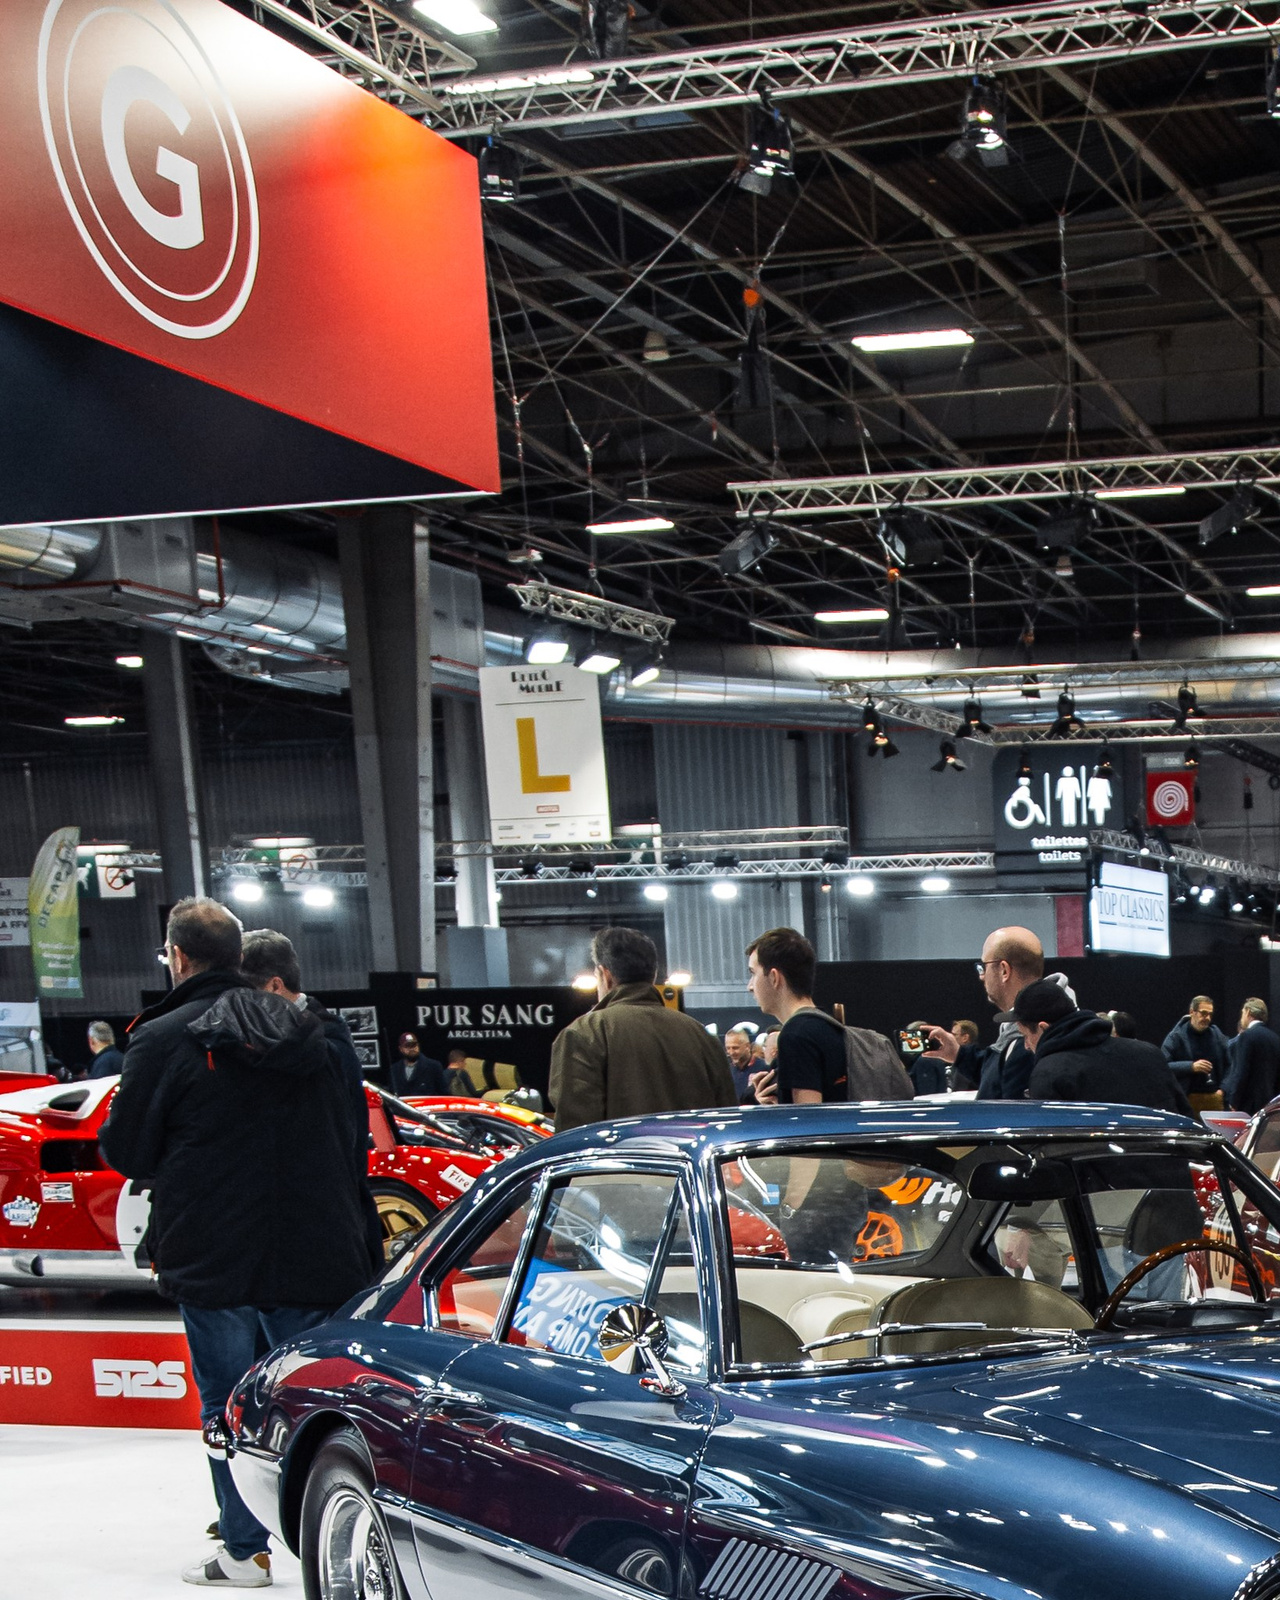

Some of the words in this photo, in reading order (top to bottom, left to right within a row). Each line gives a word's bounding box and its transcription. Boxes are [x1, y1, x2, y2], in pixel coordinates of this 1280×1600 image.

[101, 65, 205, 250] G
[516, 717, 571, 794] L
[1031, 835, 1089, 848] toilettes
[1039, 850, 1082, 862] toilets
[1098, 890, 1118, 917] TOP
[1119, 893, 1165, 923] CLASSICS
[417, 1004, 473, 1027] PUR
[481, 1003, 554, 1026] SANG
[447, 1029, 512, 1038] ARGENTINA
[92, 1358, 187, 1400] 512S
